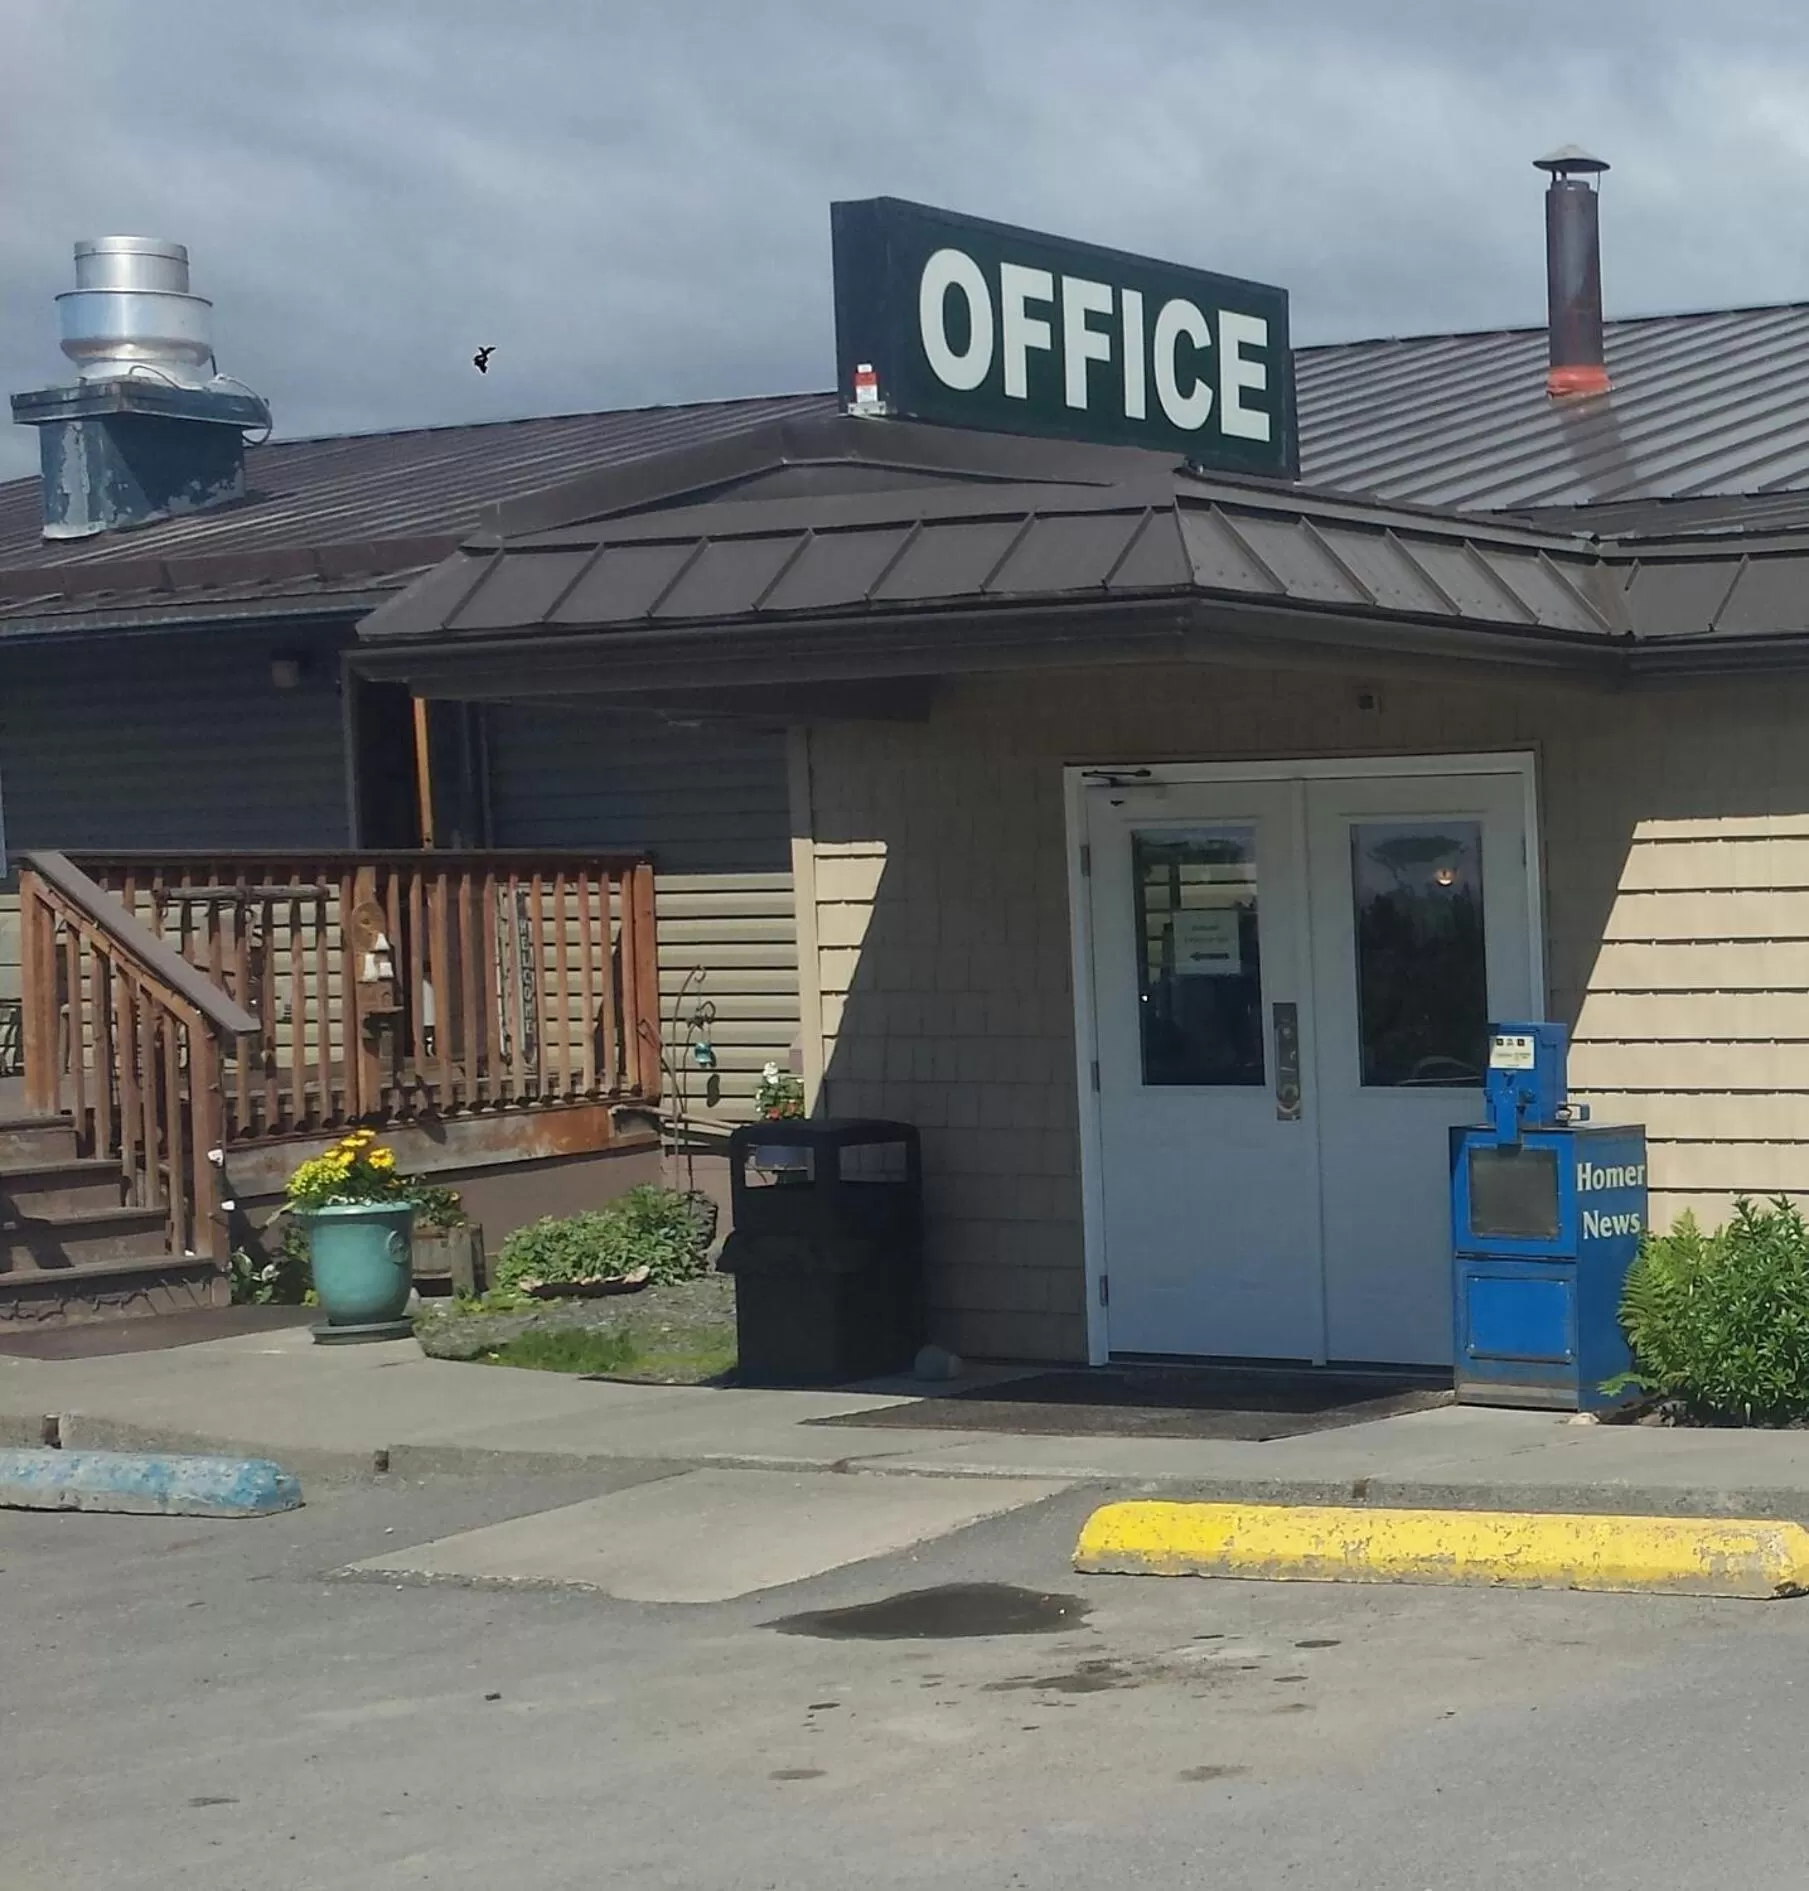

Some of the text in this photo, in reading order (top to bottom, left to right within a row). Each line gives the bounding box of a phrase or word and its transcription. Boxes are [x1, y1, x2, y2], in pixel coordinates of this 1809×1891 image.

[919, 248, 1271, 442] OFFICE
[1577, 1162, 1645, 1192] Homer
[1583, 1210, 1641, 1239] News
